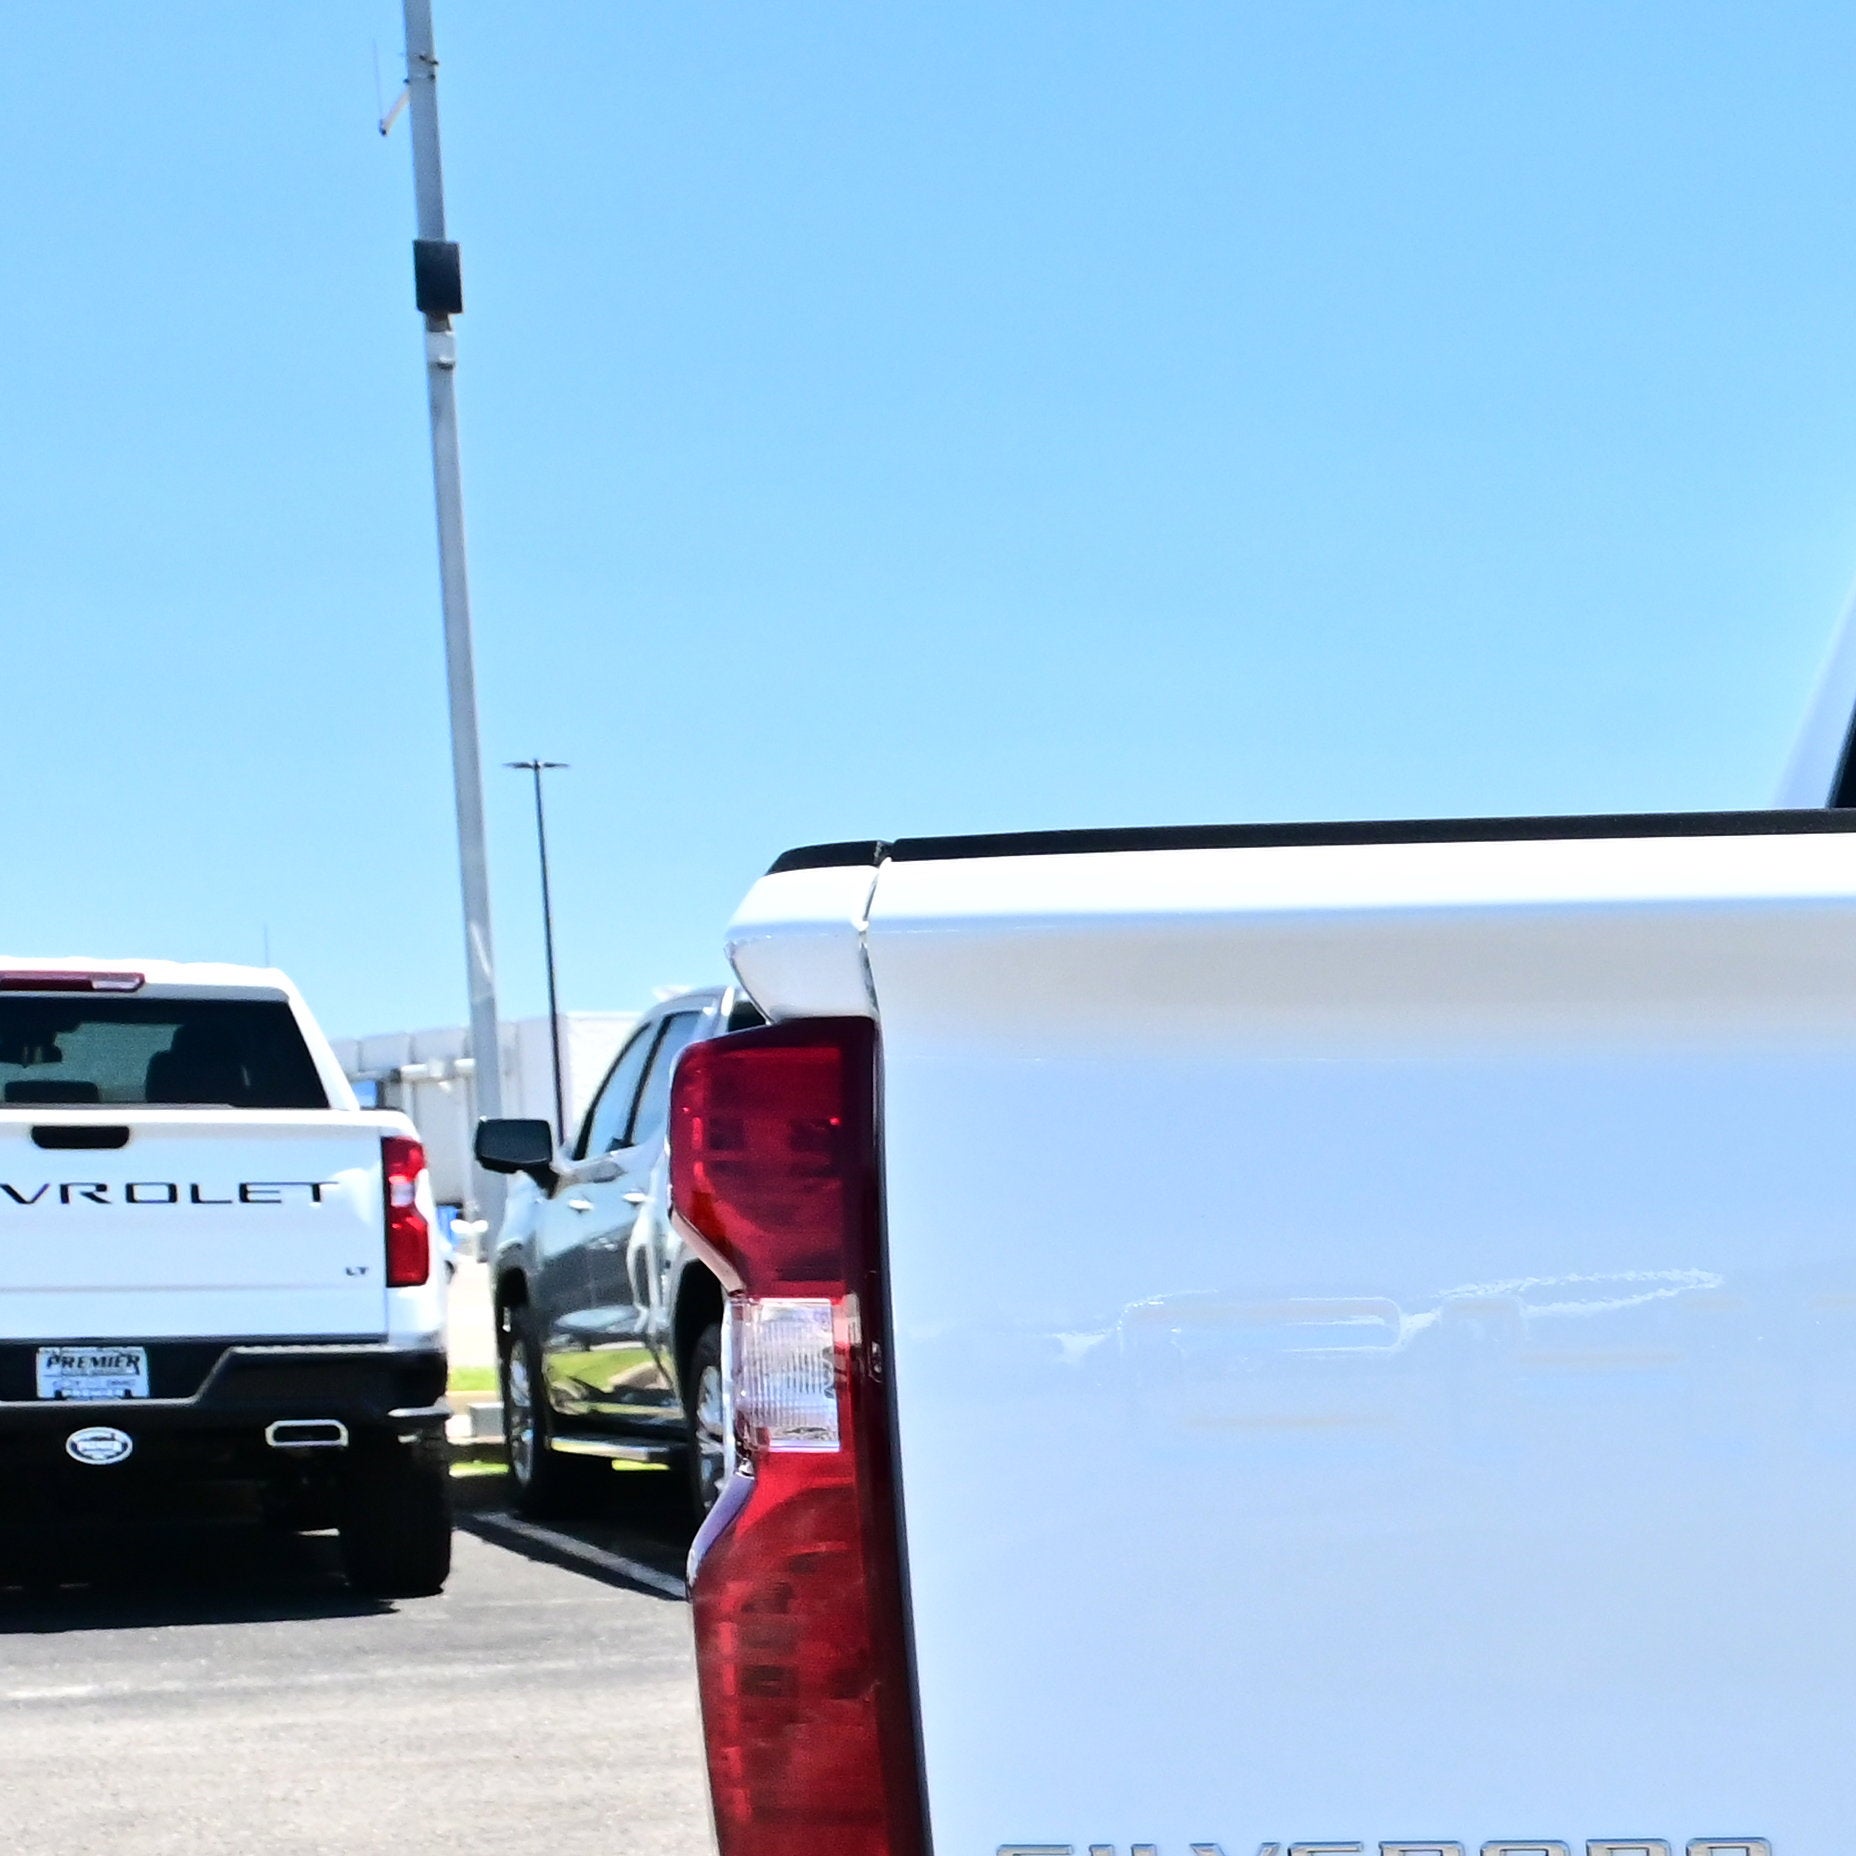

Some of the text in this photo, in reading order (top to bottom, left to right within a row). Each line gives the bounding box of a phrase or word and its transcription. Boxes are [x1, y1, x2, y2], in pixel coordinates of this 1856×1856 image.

[0, 1181, 339, 1205] VROLET
[345, 1266, 369, 1276] LT
[46, 1353, 140, 1375] PREMIER
